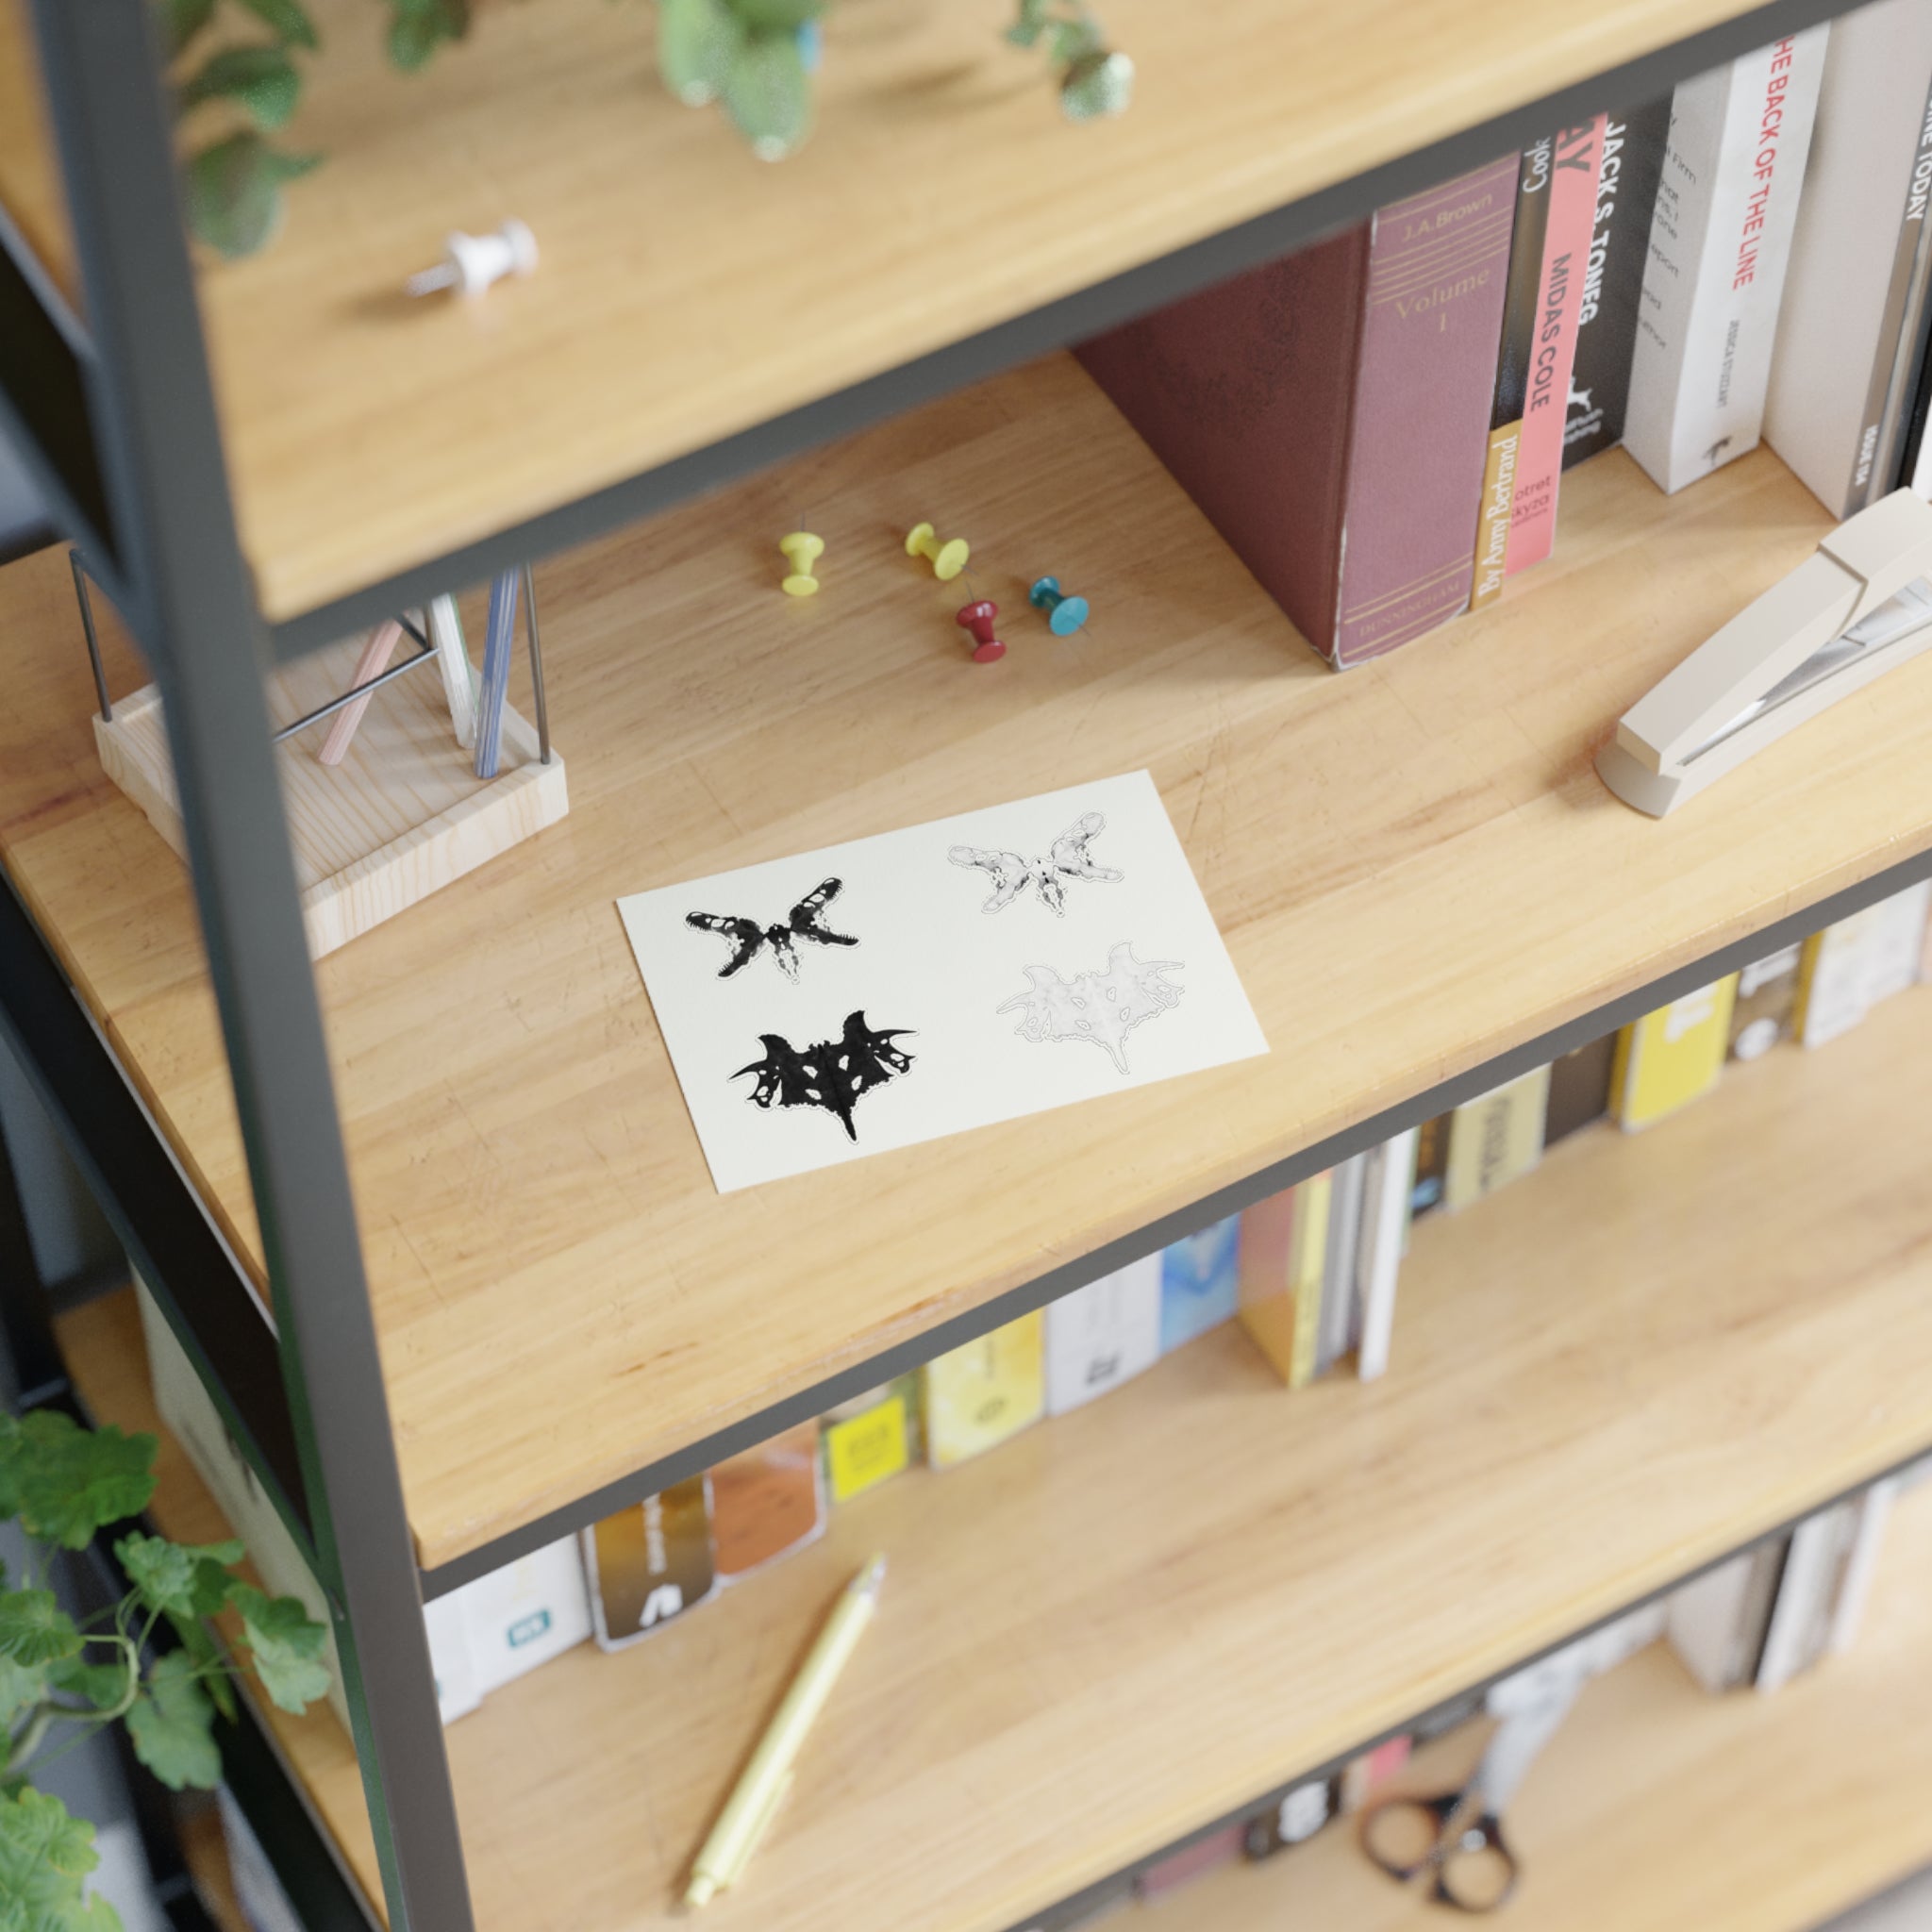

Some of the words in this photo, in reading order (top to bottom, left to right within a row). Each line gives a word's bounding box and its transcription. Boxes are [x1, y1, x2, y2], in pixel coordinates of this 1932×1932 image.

[1771, 34, 1795, 75] HE
[1759, 75, 1790, 145] BACK
[1556, 118, 1594, 173] AY
[1597, 120, 1627, 199] JACK
[1753, 146, 1777, 181] OF
[1742, 183, 1771, 236] THE
[1732, 234, 1761, 291] LINE
[1394, 269, 1491, 321] Volume
[1541, 252, 1573, 342] MIDAS
[1530, 345, 1557, 413] COLE
[1486, 433, 1518, 520] Bertrand
[1477, 568, 1507, 598] By
